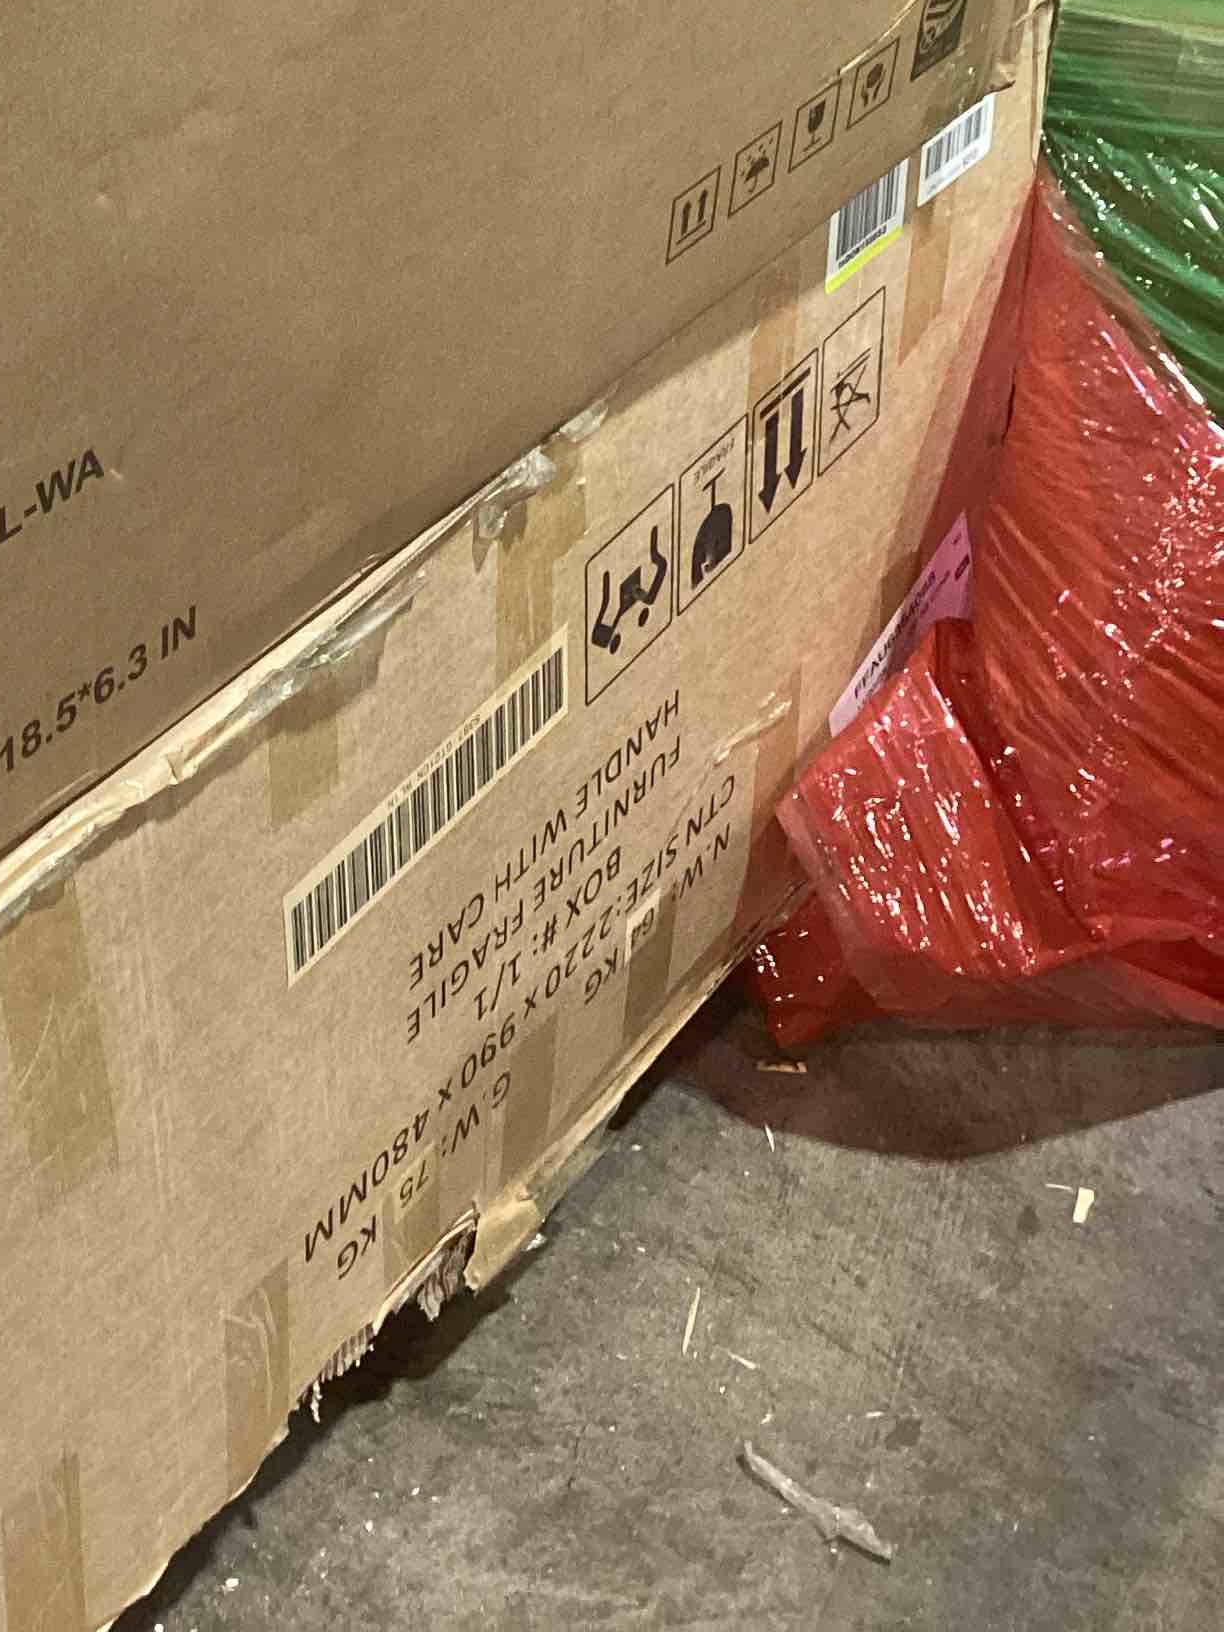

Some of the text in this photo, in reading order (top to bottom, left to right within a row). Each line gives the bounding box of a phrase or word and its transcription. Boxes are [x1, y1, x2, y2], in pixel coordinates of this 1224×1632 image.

[160, 605, 198, 661] IN
[575, 688, 680, 820] HANDLE
[533, 735, 682, 914] FURNITURE
[687, 774, 736, 847] CTN
[494, 808, 569, 903] WITH
[566, 844, 623, 930] BOX
[407, 898, 525, 1047] FRAGILE
[409, 892, 485, 991] CARE
[583, 946, 619, 1006] KG
[473, 950, 522, 1022] 1/1
[304, 1108, 430, 1264] 480MM
[398, 1159, 430, 1209] 75
[336, 1214, 377, 1282] KG
